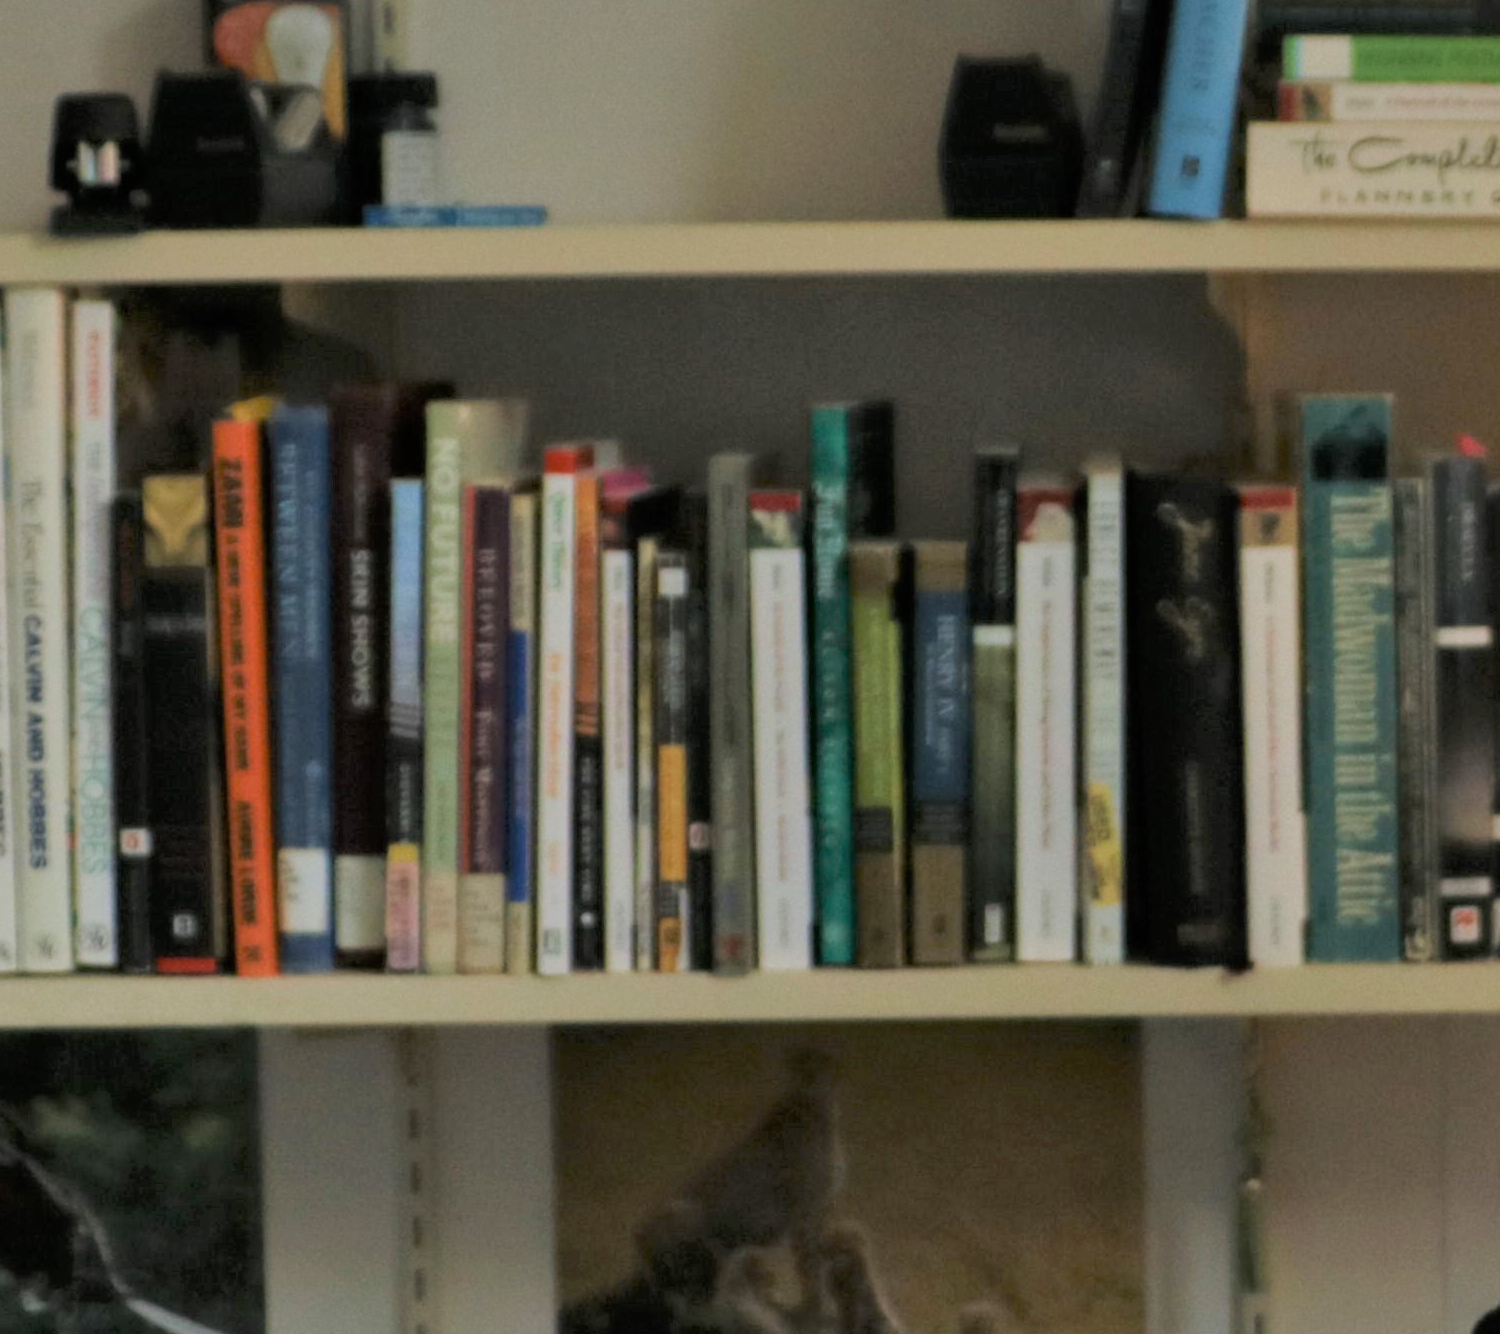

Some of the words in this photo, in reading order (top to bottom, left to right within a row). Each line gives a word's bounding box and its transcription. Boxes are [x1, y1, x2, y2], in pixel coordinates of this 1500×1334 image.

[1288, 136, 1336, 175] The
[1319, 190, 1476, 208] FLANNERY
[22, 477, 44, 515] The
[218, 455, 243, 528] ZAMI
[432, 436, 457, 493] NO
[273, 441, 299, 584] BETWEEN
[815, 479, 847, 537] Fun
[1155, 501, 1215, 581] Jane
[1332, 487, 1393, 550] The
[21, 518, 44, 610] Essential
[350, 547, 373, 606] SKIN
[432, 501, 458, 645] FUTURE
[815, 538, 839, 602] Home
[275, 591, 300, 657] MEN
[476, 548, 497, 682] BELOVED
[935, 613, 957, 688] HENRY
[1154, 594, 1217, 664] Eyre
[22, 613, 43, 706] CALVIN
[80, 605, 107, 722] CALVIN
[350, 612, 372, 708] SHOWS
[1333, 555, 1394, 747] Madwoman
[25, 709, 45, 762] AND
[476, 709, 494, 751] Toni
[936, 696, 957, 717] IV
[1335, 752, 1395, 785] in
[27, 766, 48, 870] HOBBES
[81, 753, 108, 877] HOBBES
[474, 766, 493, 867] Morrison
[1336, 790, 1395, 840] the
[1336, 847, 1397, 928] Attic
